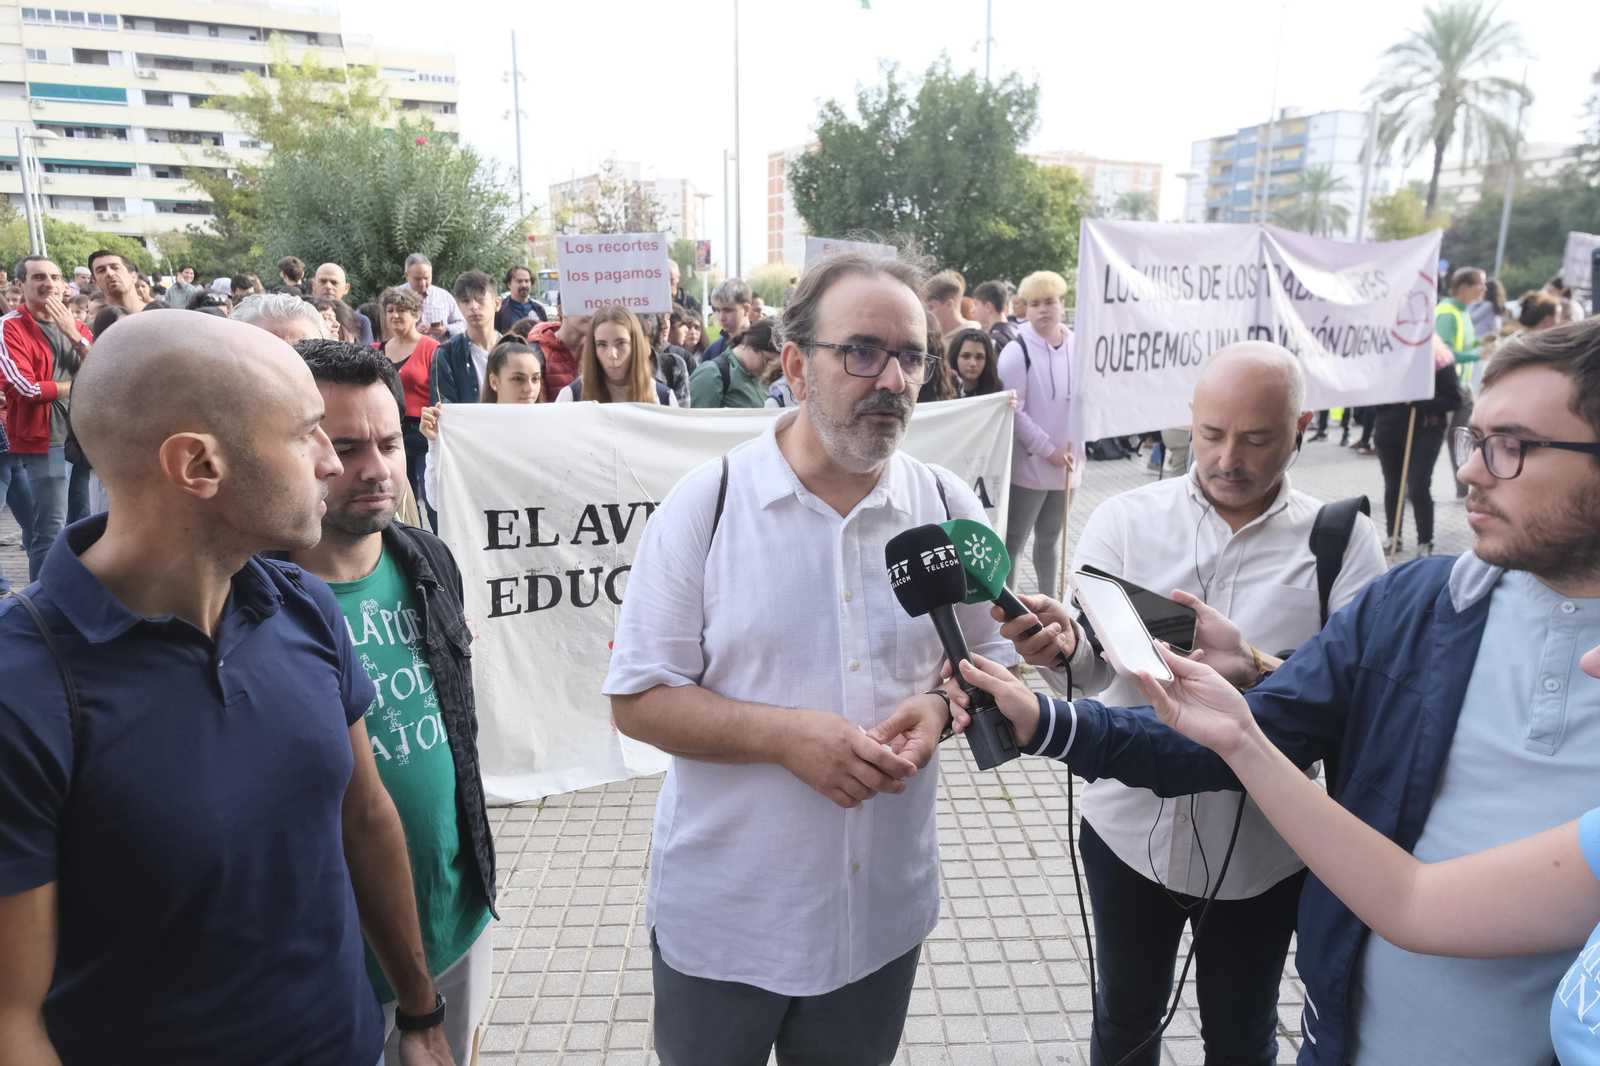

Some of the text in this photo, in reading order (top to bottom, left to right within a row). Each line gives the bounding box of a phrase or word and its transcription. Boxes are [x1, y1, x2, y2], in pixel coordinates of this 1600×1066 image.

[565, 240, 659, 254] Los recortes
[567, 268, 662, 284] los pagamos
[1199, 265, 1222, 301] DE
[1226, 264, 1258, 300] LOS
[585, 296, 650, 309] nosotras
[1095, 329, 1203, 378] QUEREMOS
[1341, 325, 1394, 358] DIGNA
[483, 507, 560, 550] EL
[925, 559, 960, 573] TELECOM
